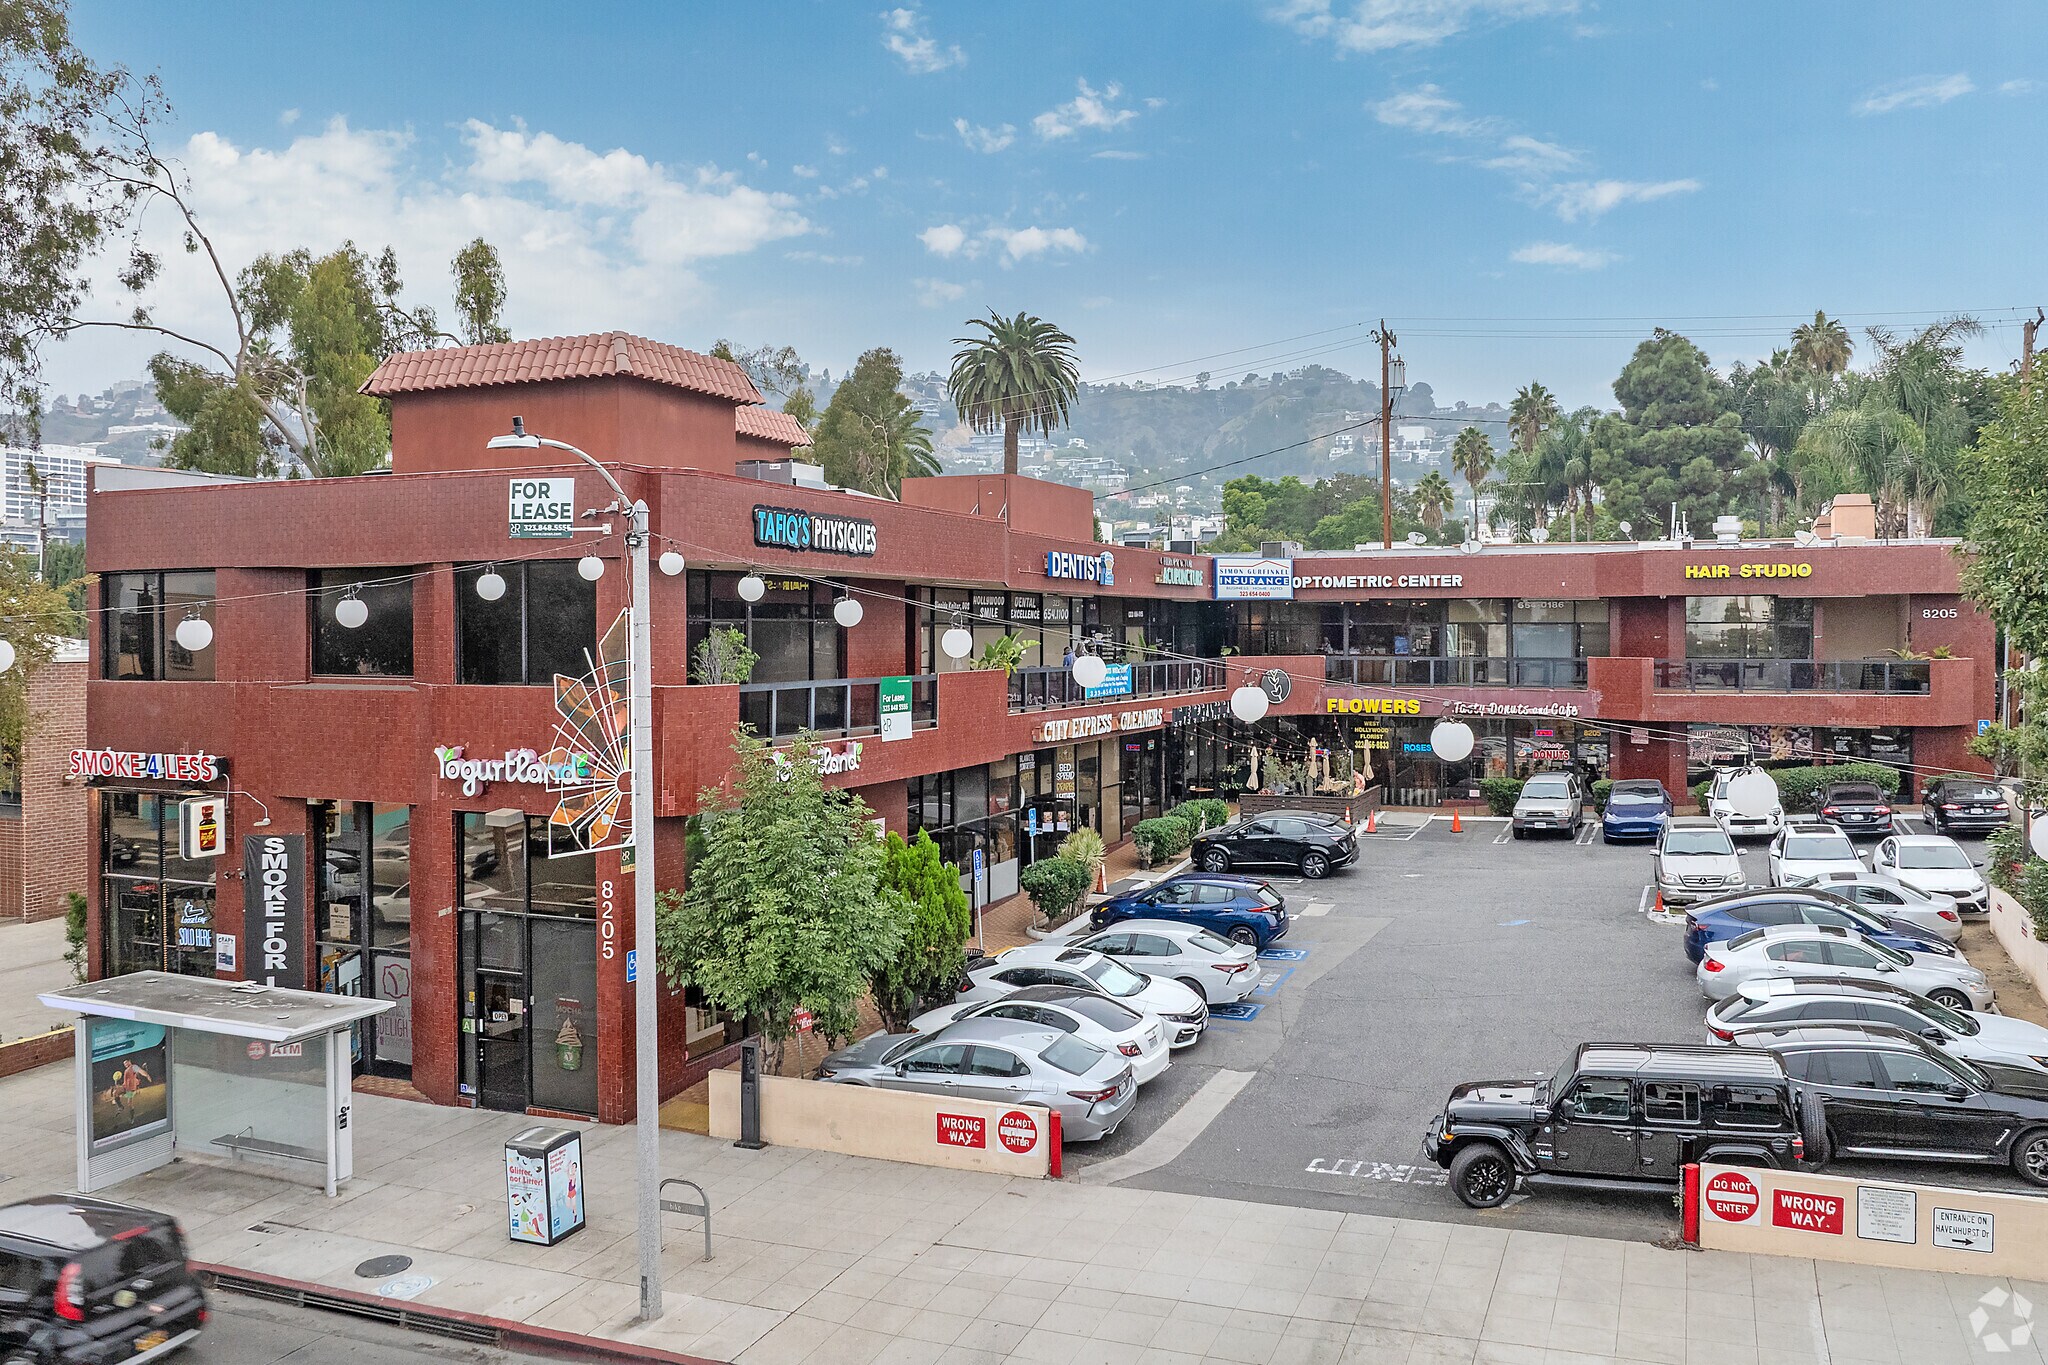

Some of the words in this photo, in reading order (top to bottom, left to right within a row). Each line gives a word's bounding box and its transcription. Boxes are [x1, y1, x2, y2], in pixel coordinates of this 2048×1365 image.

[511, 482, 550, 499] FOR
[511, 502, 571, 520] LEASE
[758, 511, 810, 546] TAFIQ'S
[814, 518, 877, 554] PHYSIQUES
[1052, 551, 1101, 581] DENTIST
[1685, 565, 1730, 579] HAIR
[1739, 563, 1813, 579] STUDIO
[1163, 567, 1203, 586] ACUPUNCTURE
[1219, 576, 1289, 585] INSURANCE
[1292, 576, 1393, 589] OPTOMETRIC
[1397, 575, 1463, 588] CENTER
[972, 595, 1006, 606] HOLLYWOOD
[1014, 596, 1036, 608] DENTAL
[979, 607, 999, 618] SMILE
[1010, 609, 1041, 620] EXCELLENCE
[1922, 608, 1958, 619] 8205
[882, 694, 891, 703] For
[891, 694, 906, 702] Lease
[1326, 698, 1421, 714] FLOWERS
[1453, 701, 1486, 716] Tasty
[1488, 702, 1529, 715] Donuts
[1532, 706, 1549, 714] and
[1550, 702, 1579, 717] Cafe
[1043, 720, 1070, 742] CITY
[1071, 713, 1113, 738] EXPRESS
[1120, 708, 1164, 731] CLEANERS
[1583, 729, 1602, 737] 8205
[1403, 743, 1432, 752] ROSES
[1532, 749, 1570, 760] DONUTS
[70, 750, 142, 778] SMOKE
[147, 754, 160, 778] 4
[165, 755, 215, 782] LESS
[434, 747, 583, 797] Yogurtland
[1058, 763, 1072, 772] BED
[261, 837, 289, 918] SMOKE
[601, 880, 615, 959] 8205
[178, 927, 195, 947] SOLD
[195, 928, 212, 948] HERE
[262, 921, 288, 970] FOR
[493, 1012, 508, 1021] OPEN
[271, 1044, 301, 1055] ATM
[941, 1116, 981, 1132] WRONG
[1003, 1117, 1015, 1126] DO
[1015, 1118, 1032, 1129] NOT
[949, 1130, 973, 1144] WAY
[1006, 1136, 1030, 1148] ENTER
[1536, 1148, 1553, 1157] Jeep
[509, 1165, 533, 1177] Glitter,
[509, 1175, 522, 1183] not
[522, 1175, 543, 1187] Litter!
[1713, 1179, 1728, 1190] DO
[1731, 1180, 1752, 1192] NOT
[1716, 1202, 1749, 1215] ENTER
[1780, 1194, 1837, 1216] WRONG
[1940, 1211, 1975, 1224] ENTRANCE
[1977, 1216, 1988, 1225] ON
[1935, 1224, 1980, 1237] HAVENHURST
[1981, 1227, 1990, 1238] Dr
